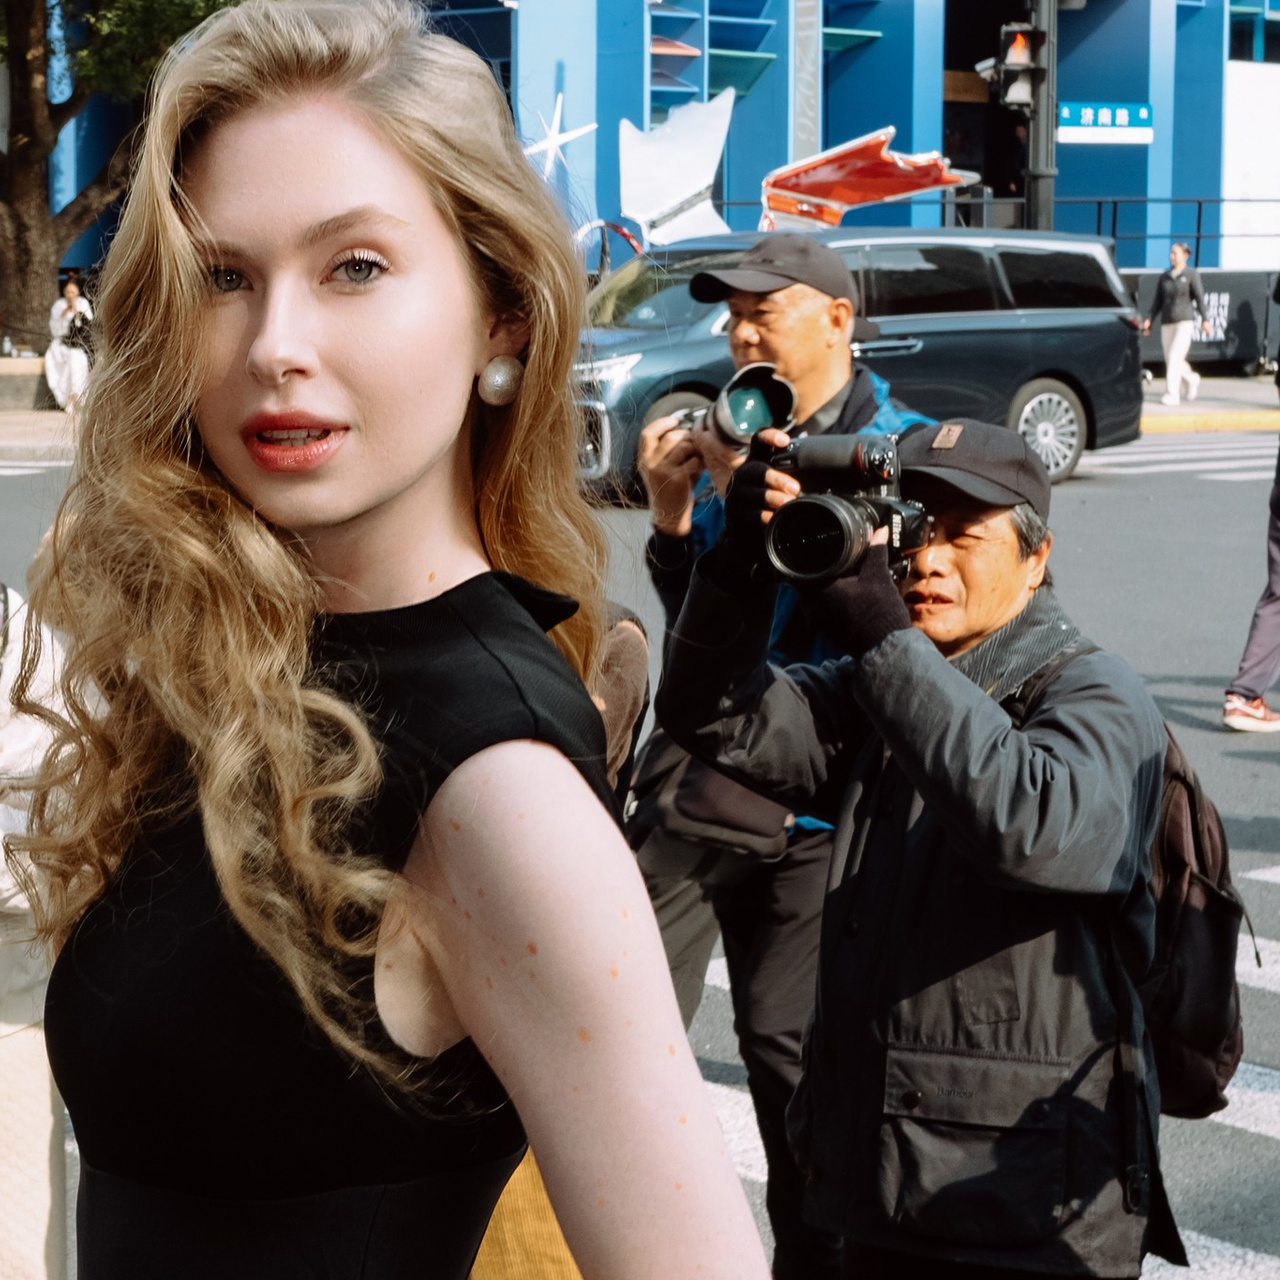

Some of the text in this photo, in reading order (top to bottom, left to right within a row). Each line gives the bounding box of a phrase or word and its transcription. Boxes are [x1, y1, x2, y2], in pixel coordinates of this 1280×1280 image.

[1080, 107, 1129, 126] 济南路
[892, 514, 902, 548] Nikon
